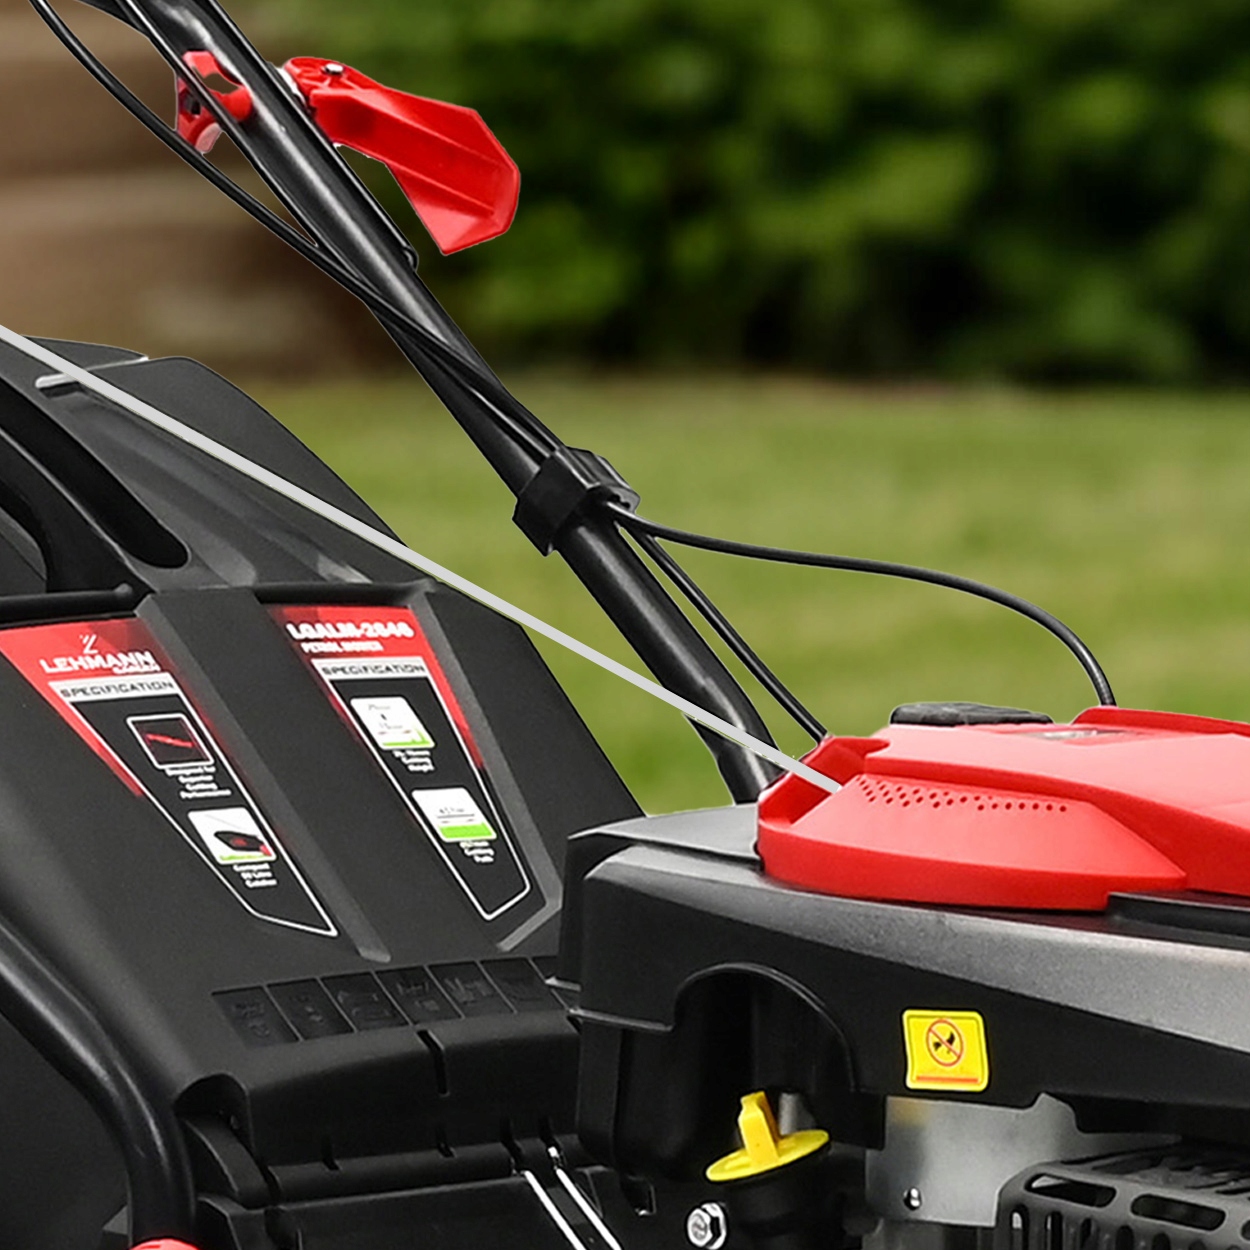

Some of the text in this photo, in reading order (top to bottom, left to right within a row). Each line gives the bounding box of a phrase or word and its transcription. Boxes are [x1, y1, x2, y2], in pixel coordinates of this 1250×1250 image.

[39, 650, 158, 674] LEHMANN
[321, 663, 426, 676] SPECIFICATION
[60, 680, 174, 698] SPECIFICATION
